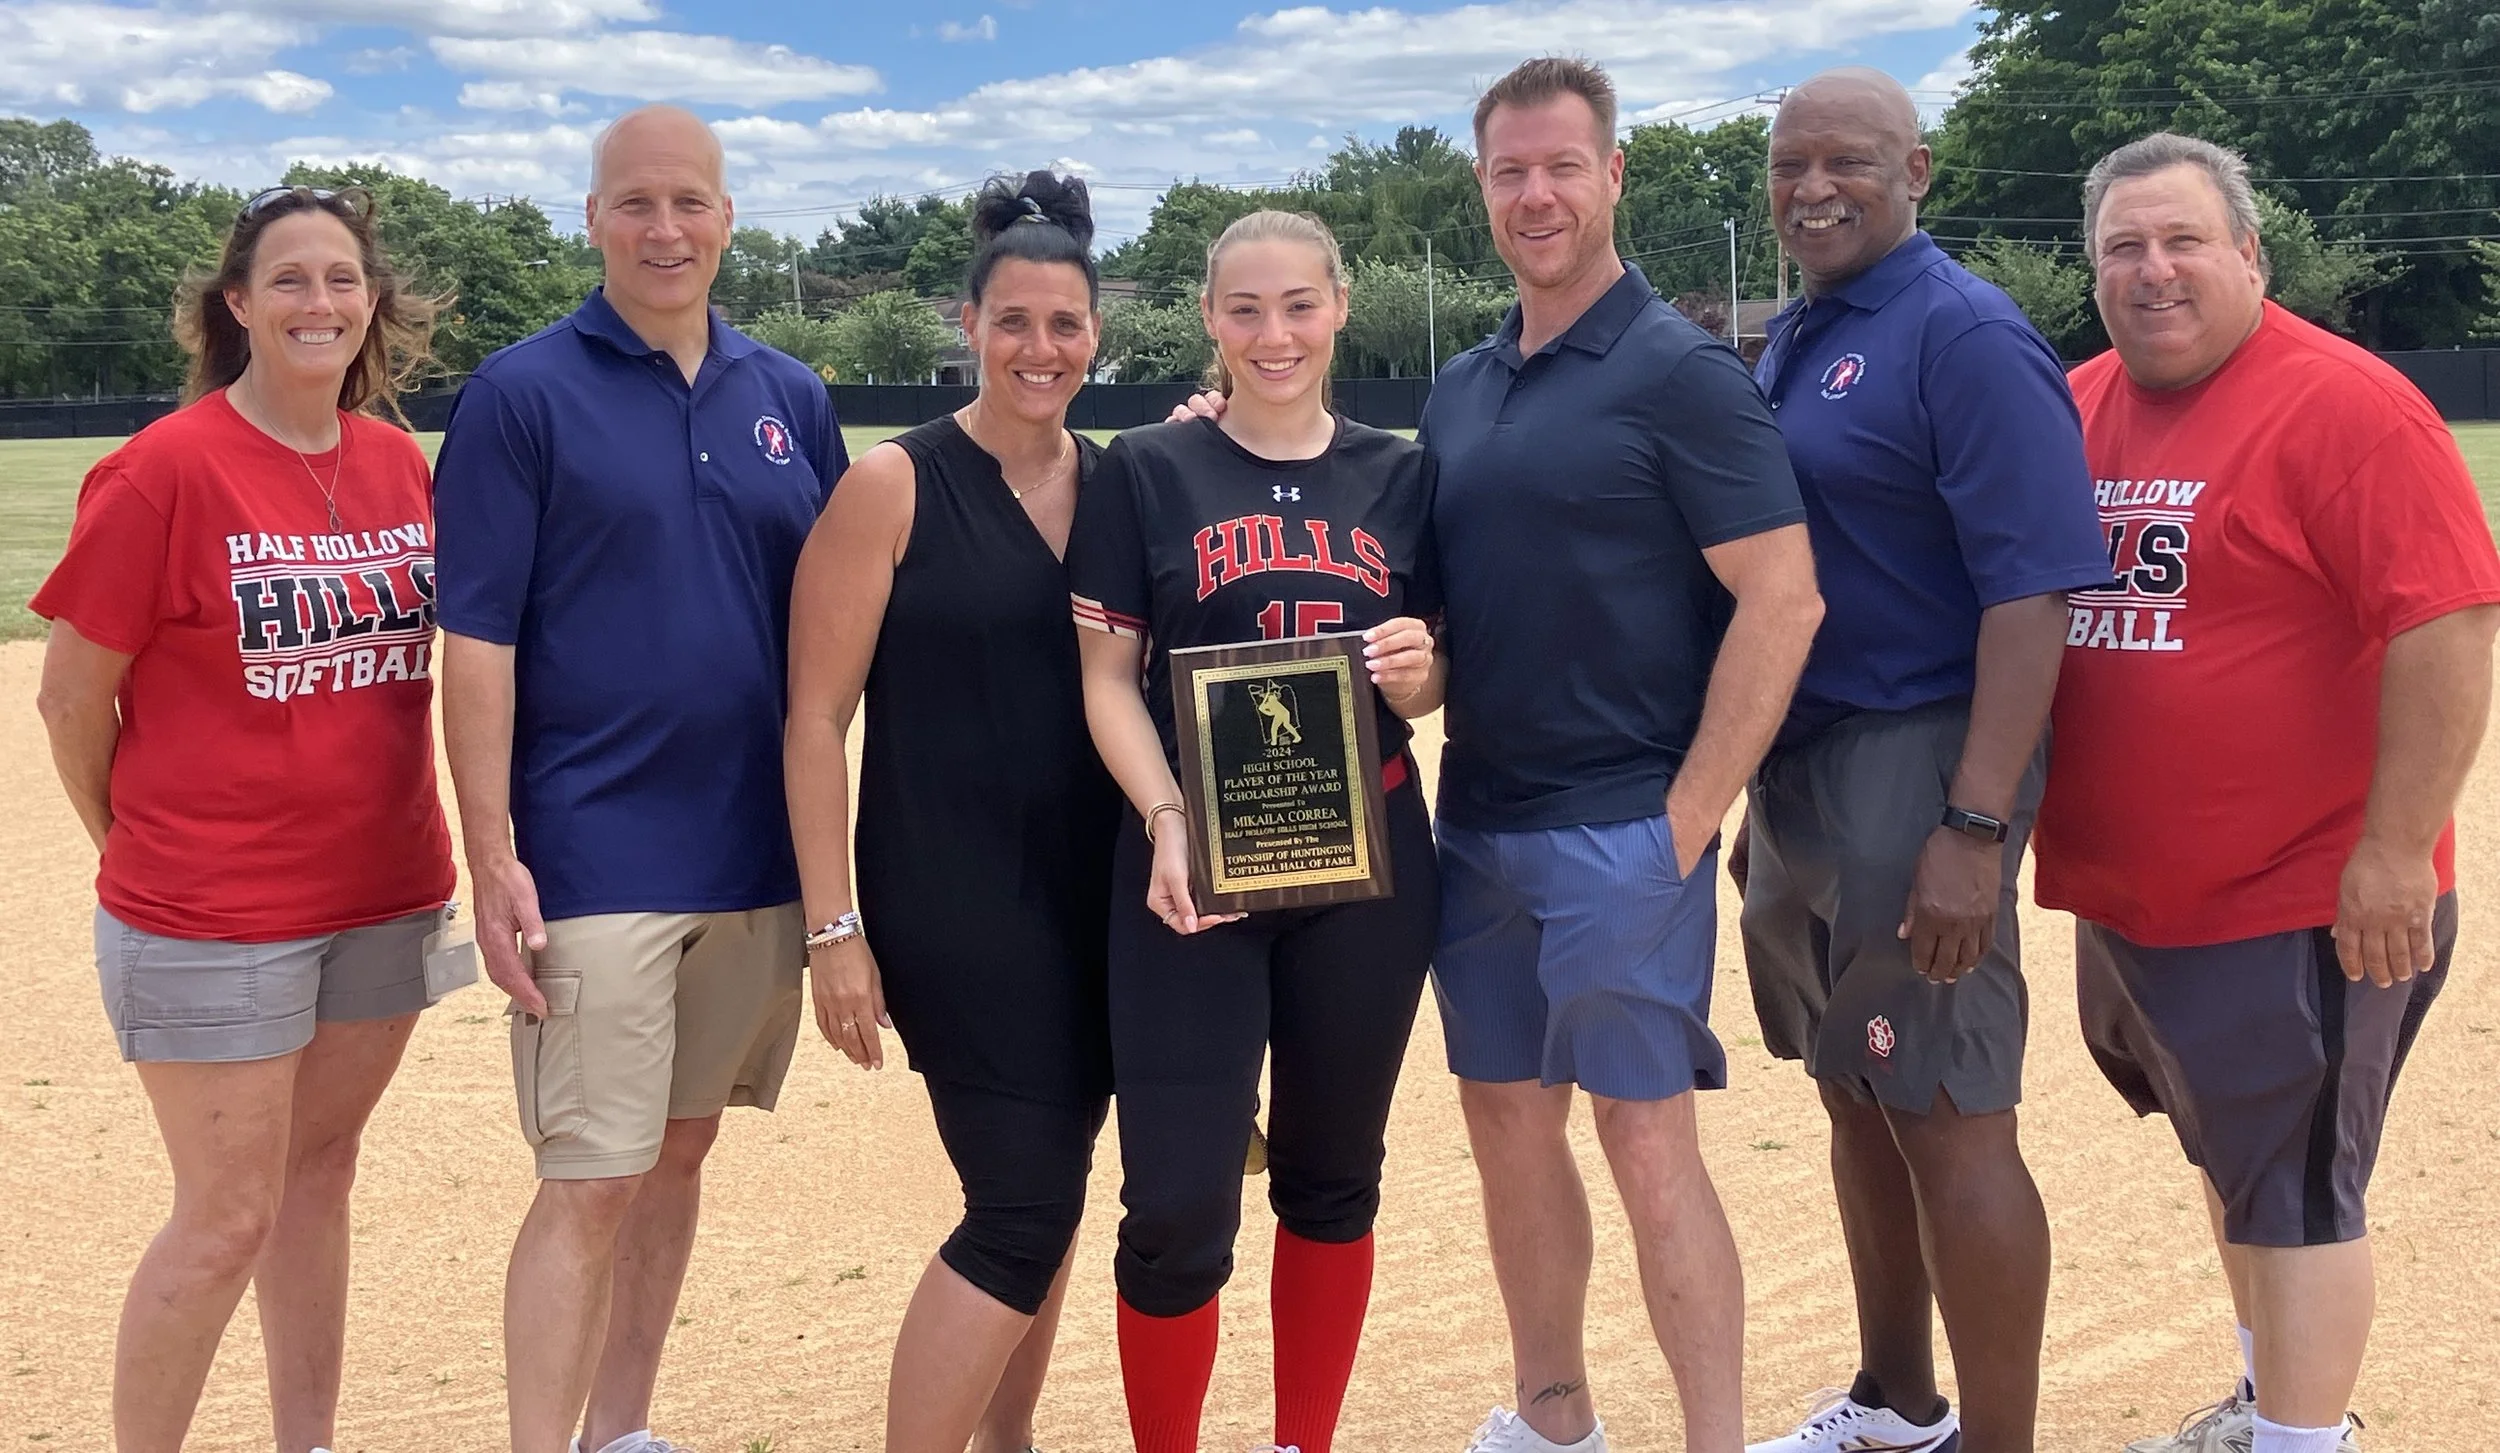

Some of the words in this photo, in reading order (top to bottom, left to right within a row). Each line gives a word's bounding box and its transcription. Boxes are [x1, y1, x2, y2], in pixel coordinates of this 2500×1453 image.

[226, 532, 305, 564] HALF
[309, 522, 429, 561] HOLLOW
[1193, 513, 1390, 602] HILLS
[2066, 607, 2183, 651] BALL
[243, 643, 430, 703] SOFTBAL
[1242, 761, 1271, 774] HIGH
[1273, 757, 1319, 771] SCHOOL
[1224, 775, 1264, 789] PLAYER
[1267, 774, 1282, 784] OF
[1285, 772, 1307, 783] THE
[1309, 769, 1338, 780] YEAR
[1223, 786, 1298, 803] SCHOLARSHIP
[1301, 781, 1342, 795] AWARD
[1233, 812, 1285, 828] MIKAILA
[1288, 807, 1338, 823] CORREA
[1224, 830, 1243, 839] HALF
[1245, 828, 1275, 837] HOLLOW
[1277, 825, 1297, 834] HILLS
[1319, 820, 1348, 830] SCHOOL
[1255, 837, 1293, 849] Presented
[1305, 835, 1319, 844] The
[1226, 852, 1275, 865] TOWNSHIP
[1276, 850, 1288, 860] OF
[1291, 844, 1353, 859] HUNTINGTON
[1228, 864, 1278, 877] SOFTBALL
[1280, 860, 1307, 872] HALL
[1309, 859, 1322, 868] OF
[1325, 856, 1354, 867] FAME
